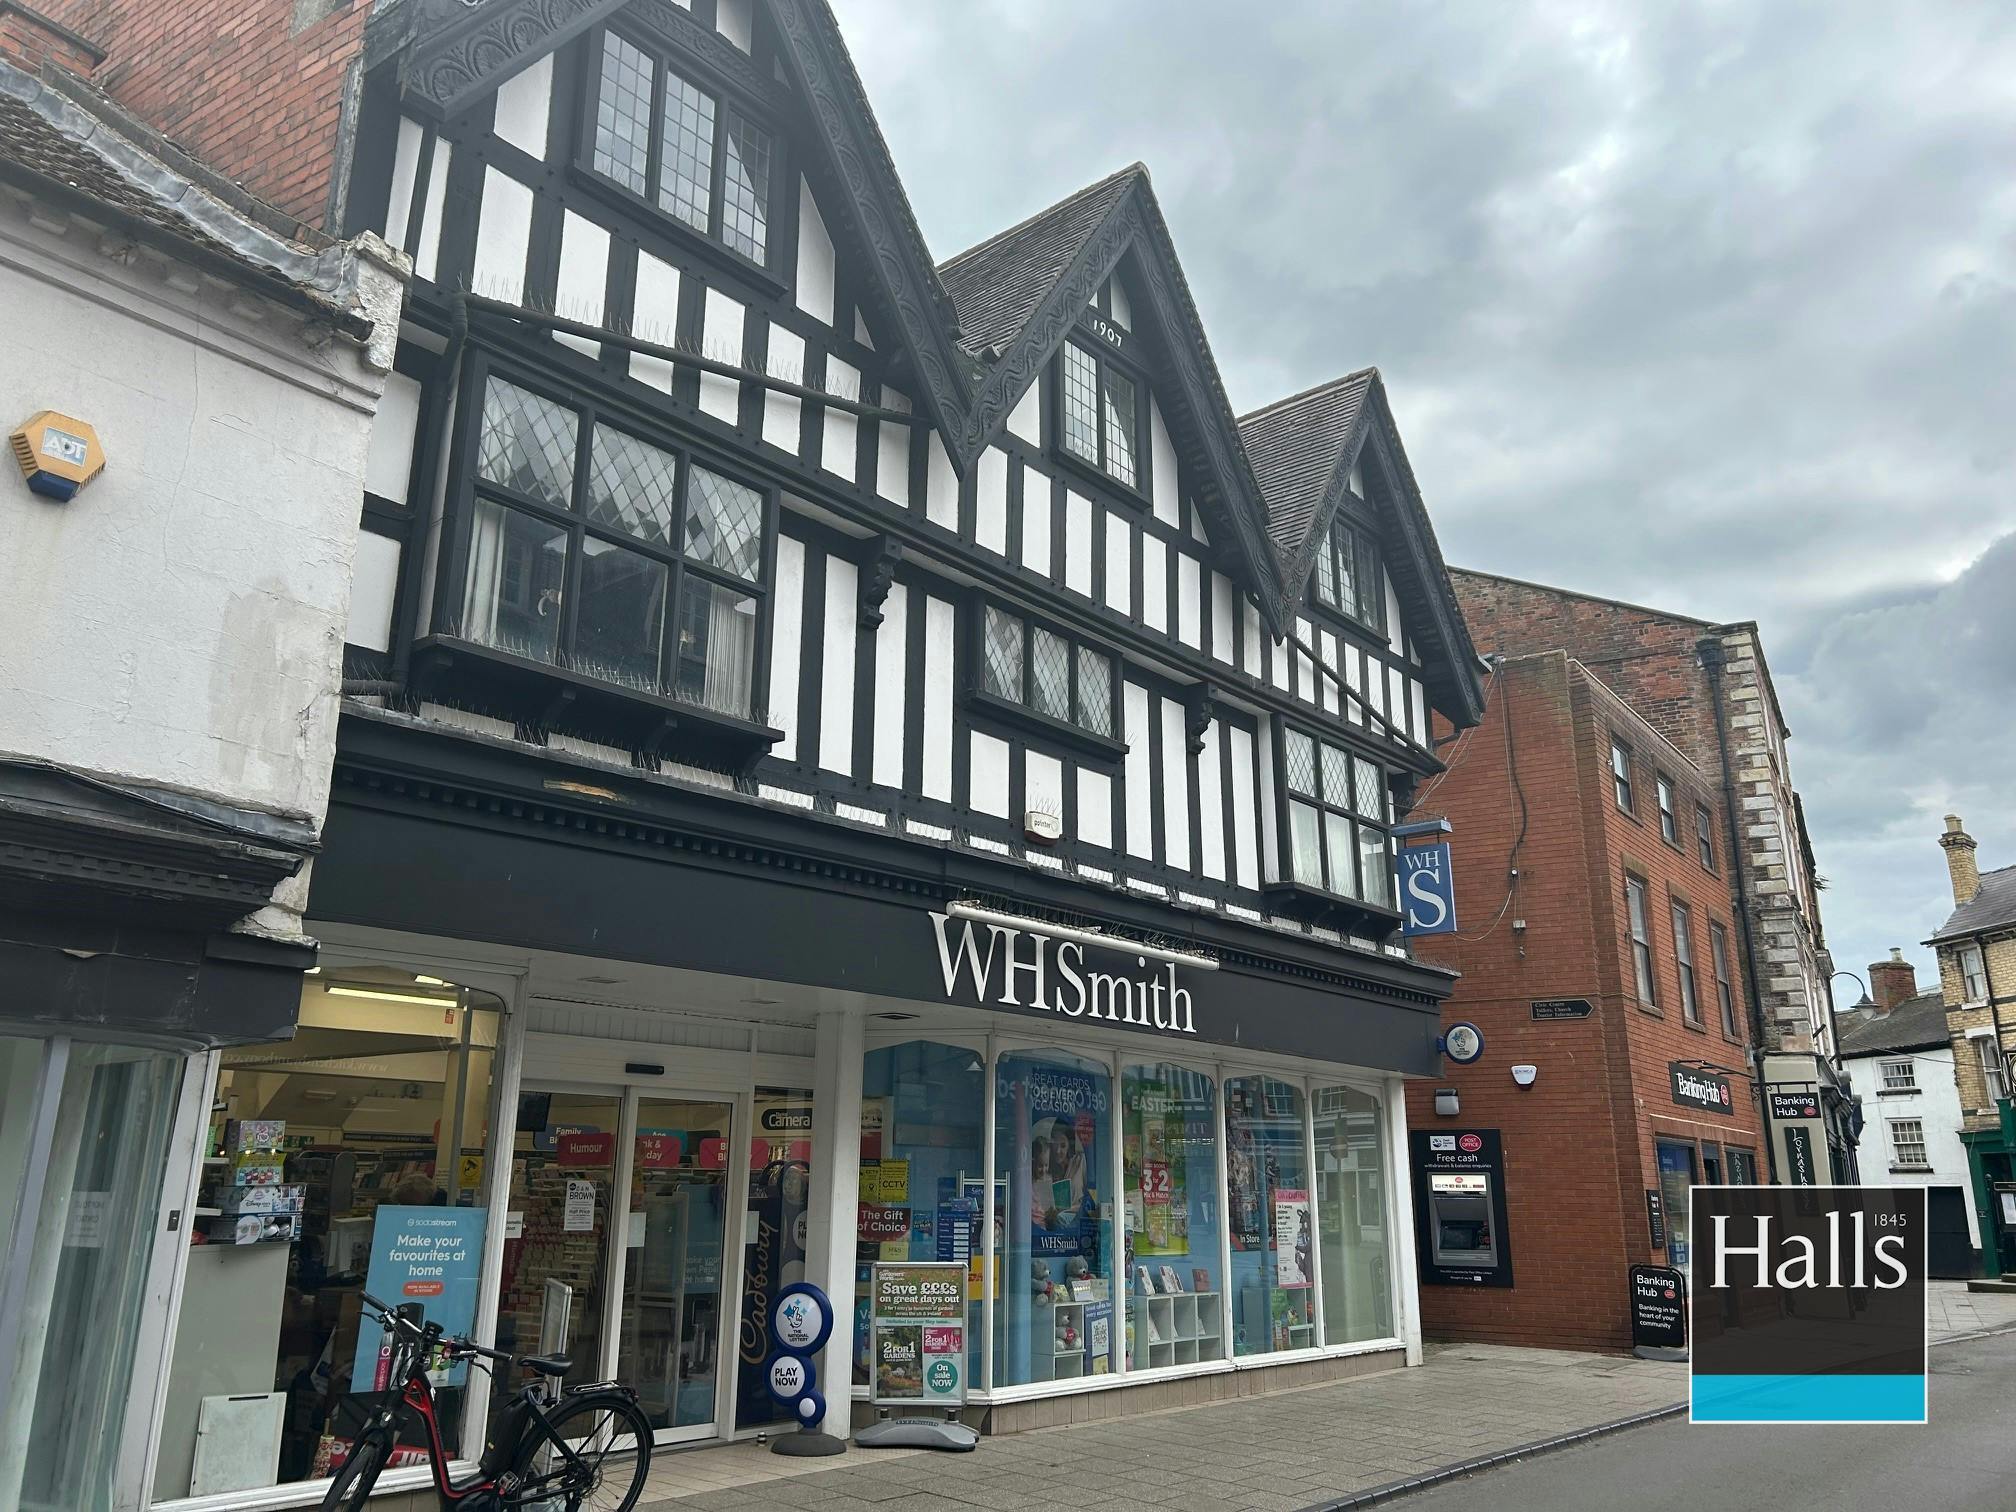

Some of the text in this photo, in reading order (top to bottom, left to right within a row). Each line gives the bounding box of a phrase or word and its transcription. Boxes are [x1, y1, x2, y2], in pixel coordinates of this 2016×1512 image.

[1093, 319, 1123, 347] 1907
[45, 436, 87, 459] ADT
[1404, 850, 1441, 870] WH
[1408, 868, 1447, 928] S
[928, 911, 1197, 1033] WHSmith
[1060, 1076, 1090, 1091] CARDS
[1676, 1073, 1706, 1105] Banking
[1706, 1080, 1720, 1104] Hub
[1131, 1096, 1176, 1114] EASTER
[1775, 1096, 1815, 1107] Banking
[1777, 1107, 1798, 1116] Hub
[769, 1114, 811, 1127] Camera
[570, 1143, 603, 1153] Humour
[1436, 1154, 1478, 1162] Free cash
[882, 1180, 906, 1189] CCTV
[1143, 1169, 1153, 1191] 3
[1158, 1170, 1169, 1192] 2
[569, 1192, 594, 1200] BROWN
[861, 1210, 881, 1220] The
[884, 1210, 903, 1220] Gift
[415, 1219, 456, 1227] sodastream
[858, 1222, 907, 1232] of Choice
[397, 1235, 462, 1249] Make your
[1041, 1236, 1078, 1249] WHSmith
[1246, 1234, 1260, 1243] Store
[389, 1249, 466, 1262] favourites at
[409, 1264, 443, 1276] home
[1636, 1274, 1675, 1289] Banking
[740, 1220, 778, 1364] Cadbury
[882, 1282, 957, 1295] Save £££s
[1637, 1286, 1658, 1297] Hub
[893, 1295, 918, 1304] great
[920, 1295, 942, 1304] days
[944, 1295, 960, 1303] out
[1639, 1304, 1662, 1313] Banking
[1640, 1320, 1671, 1329] community
[925, 1335, 932, 1343] 2
[883, 1342, 892, 1353] 2
[909, 1341, 916, 1352] 1
[775, 1368, 798, 1377] PLAY
[936, 1364, 948, 1372] On
[775, 1378, 798, 1386] NOW
[931, 1379, 953, 1387] NOW
